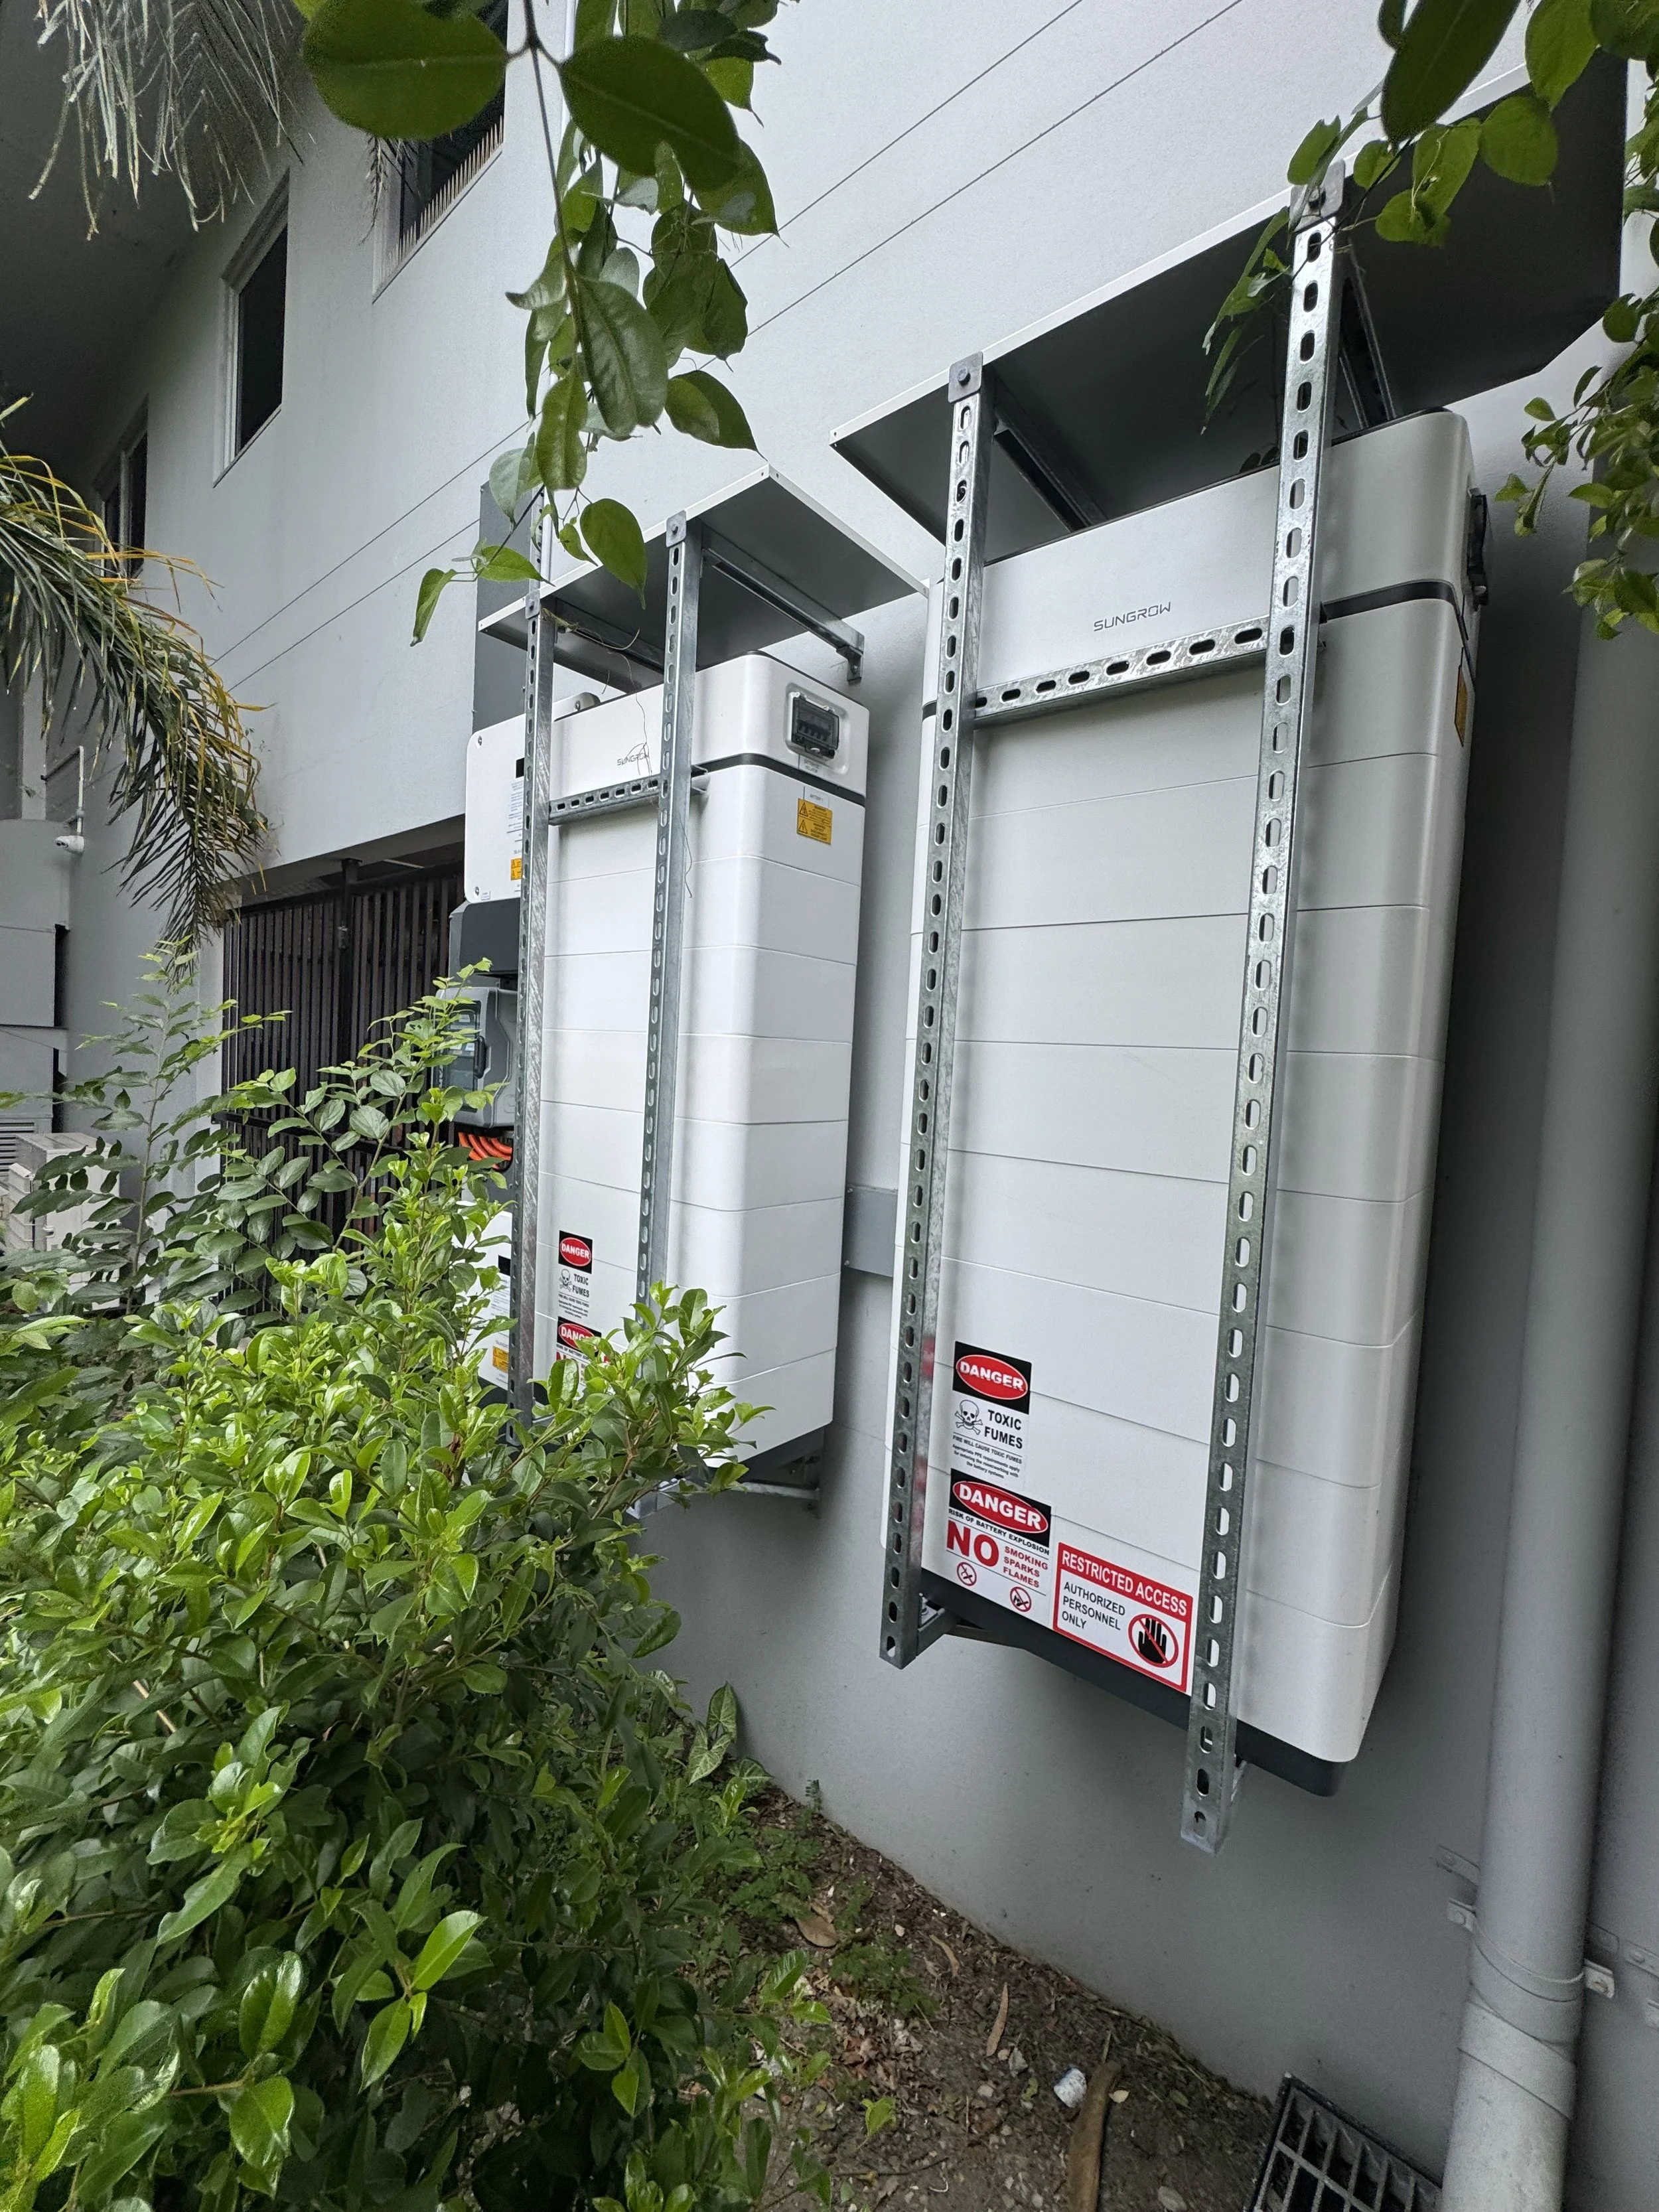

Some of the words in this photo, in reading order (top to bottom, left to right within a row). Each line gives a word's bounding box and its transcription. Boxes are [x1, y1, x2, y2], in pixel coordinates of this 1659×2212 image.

[1094, 601, 1171, 632] SUNGROW
[561, 1243, 590, 1260] DANGER
[572, 1285, 590, 1297] FUMES
[574, 1273, 589, 1286] TOXIC
[561, 1326, 591, 1342] DANG
[960, 1361, 1024, 1392] DANGER
[987, 1409, 1022, 1430] TOXIC
[984, 1426, 1023, 1449] FUMES
[960, 1484, 1041, 1530] DANGER
[947, 1520, 999, 1567] NO
[948, 1509, 964, 1519] RISK
[966, 1515, 975, 1524] OF
[976, 1520, 1007, 1537] BATTERY
[1009, 1534, 1050, 1556] EXPLOSION
[1004, 1546, 1048, 1570] SMOKING
[1004, 1556, 1040, 1578] SPARKS
[1003, 1566, 1040, 1588] FLAMES
[1062, 1550, 1133, 1593] RESTRICTED
[1135, 1582, 1187, 1616] ACCESS
[1064, 1582, 1125, 1616] AUTHORIZED
[1062, 1596, 1121, 1631] PERSONNEL
[1062, 1611, 1086, 1629] ONLY
